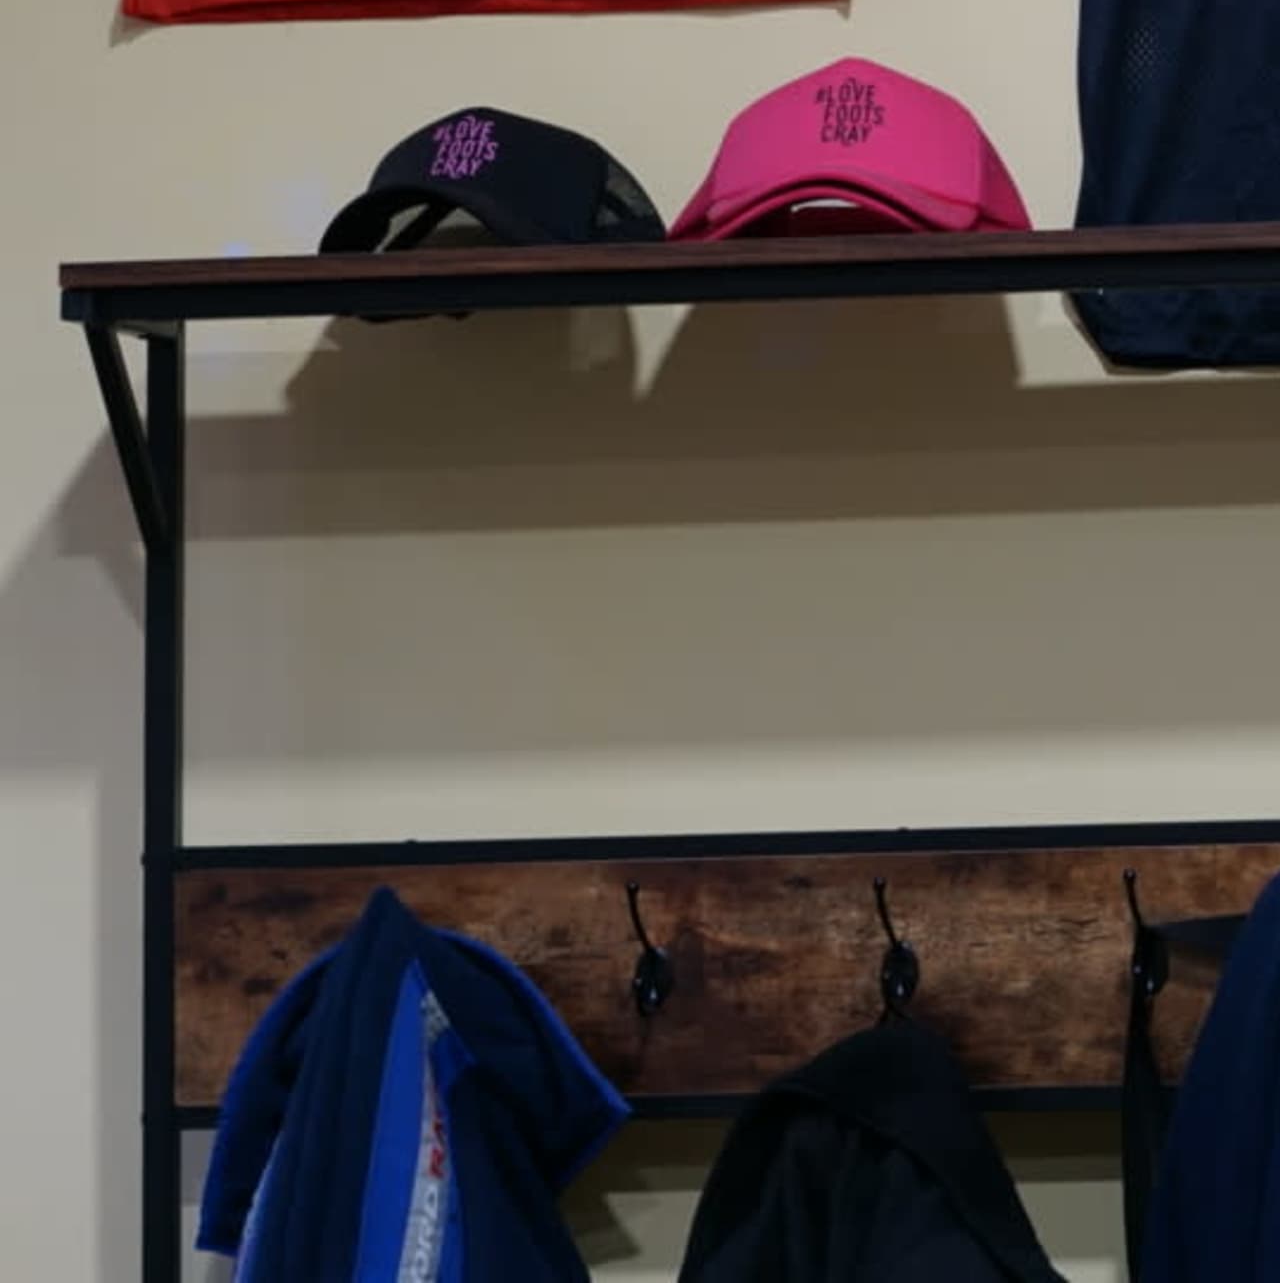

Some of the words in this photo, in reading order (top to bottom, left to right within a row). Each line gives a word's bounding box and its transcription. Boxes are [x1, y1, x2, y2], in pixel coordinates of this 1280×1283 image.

[824, 104, 885, 126] FOOTS
[820, 124, 872, 147] CRAY
[437, 139, 499, 161] FOOTS
[430, 157, 483, 179] CRAY
